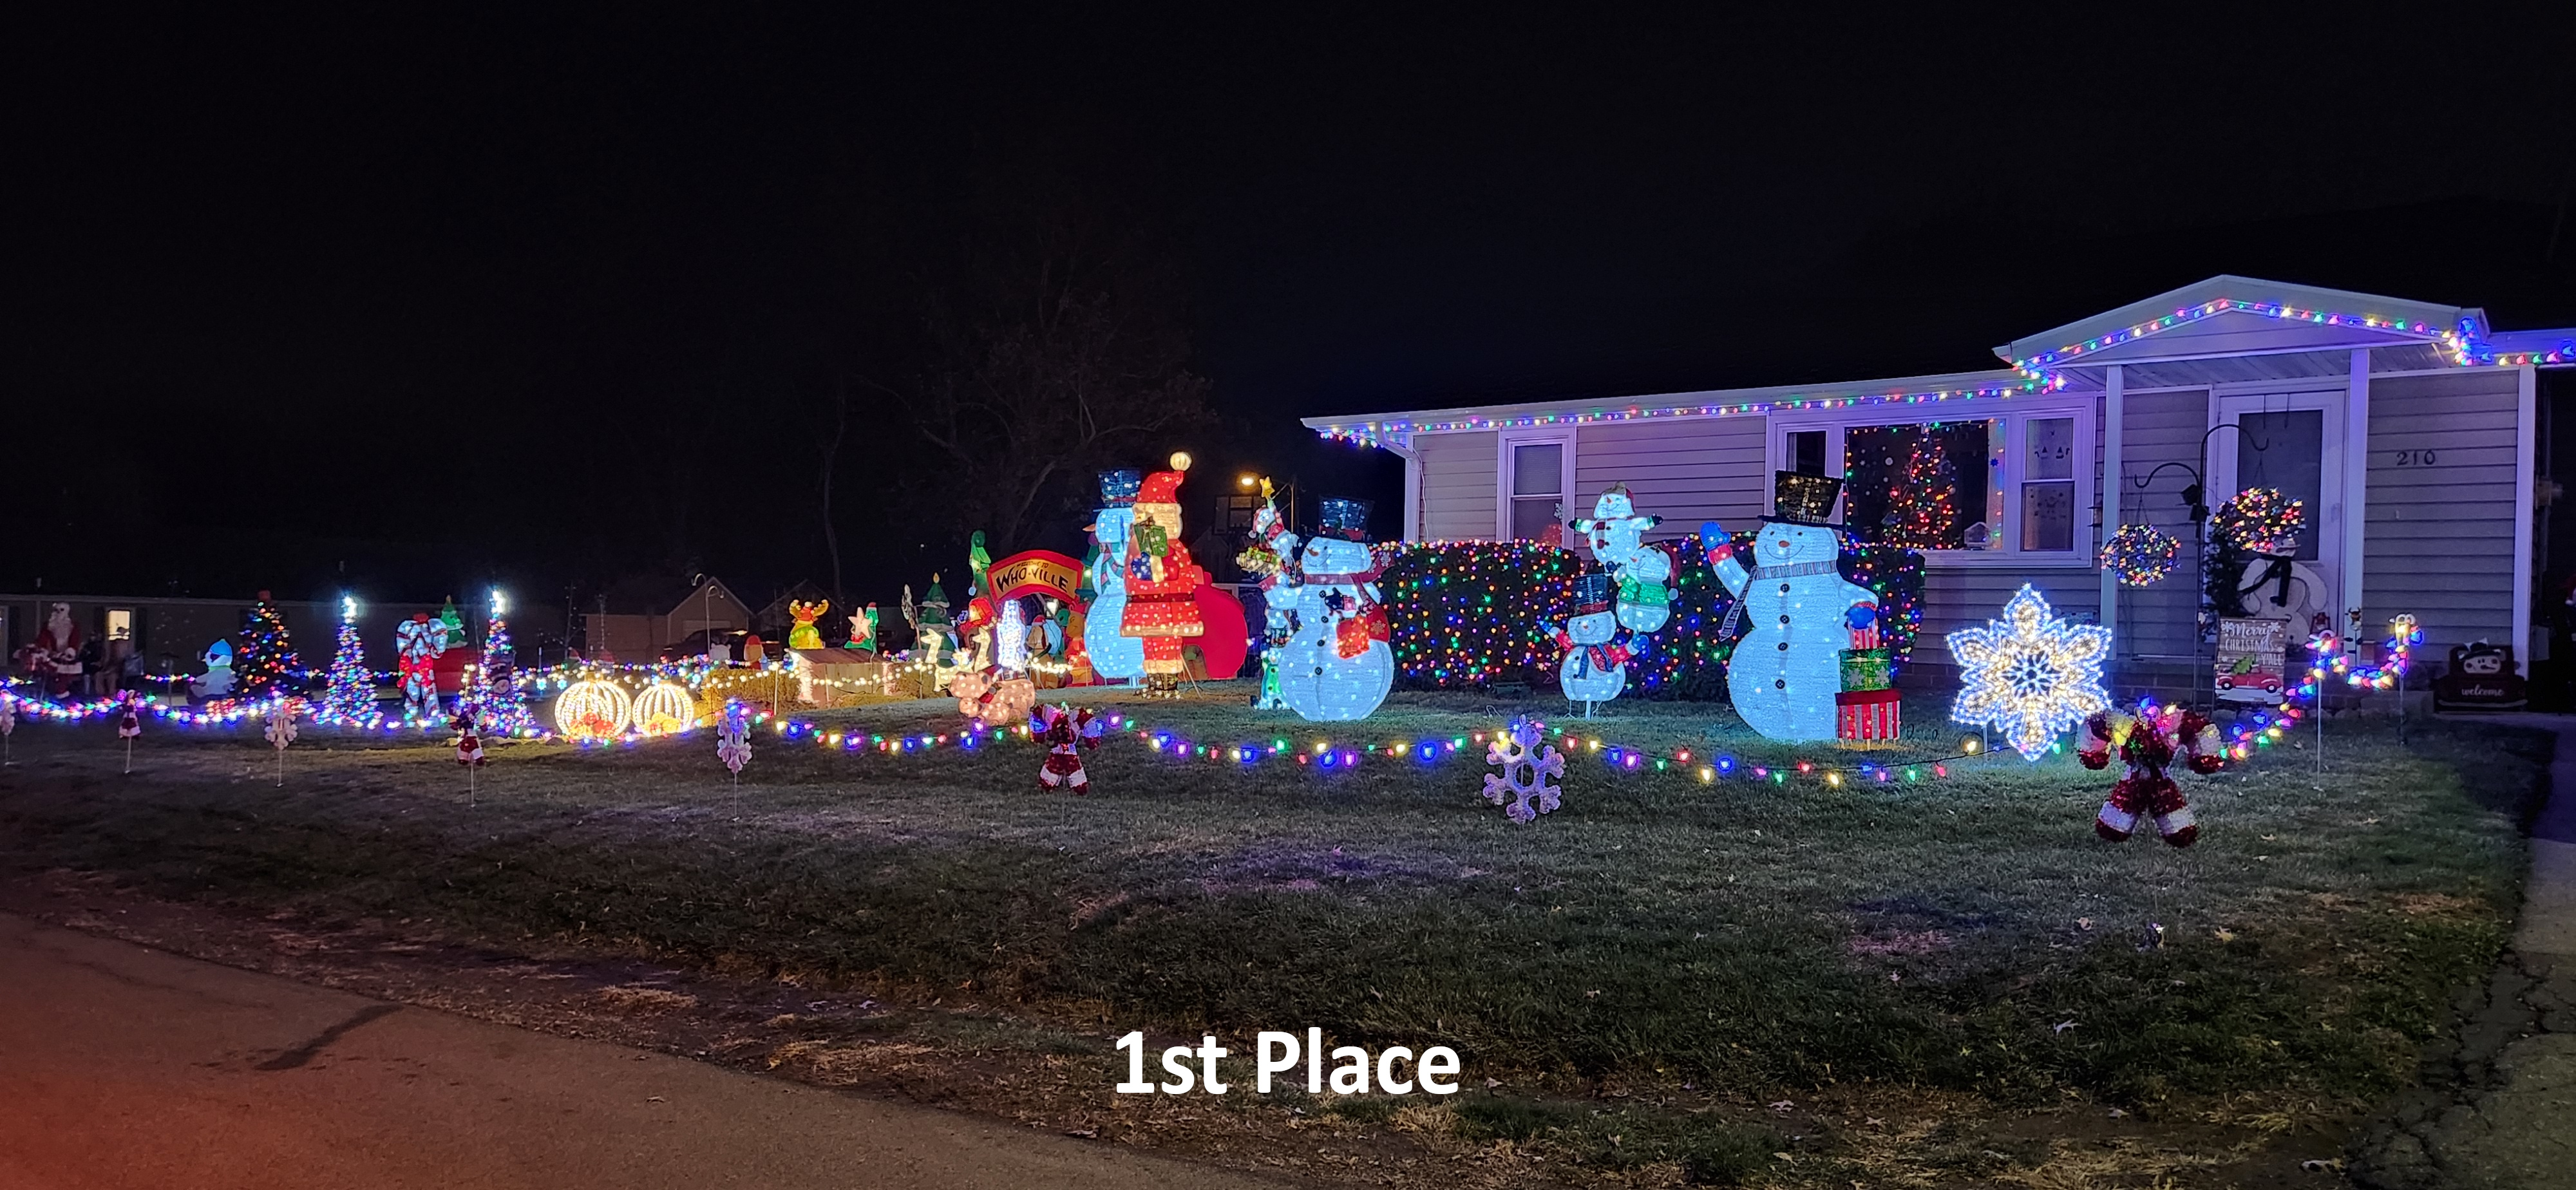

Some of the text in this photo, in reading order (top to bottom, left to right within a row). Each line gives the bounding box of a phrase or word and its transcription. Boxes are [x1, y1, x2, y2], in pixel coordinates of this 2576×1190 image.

[2396, 450, 2436, 466] 210
[2229, 622, 2272, 643] Merry
[2225, 638, 2274, 652] CHRISTMAS
[2261, 653, 2283, 666] Y'ALL
[2461, 684, 2505, 696] welcome
